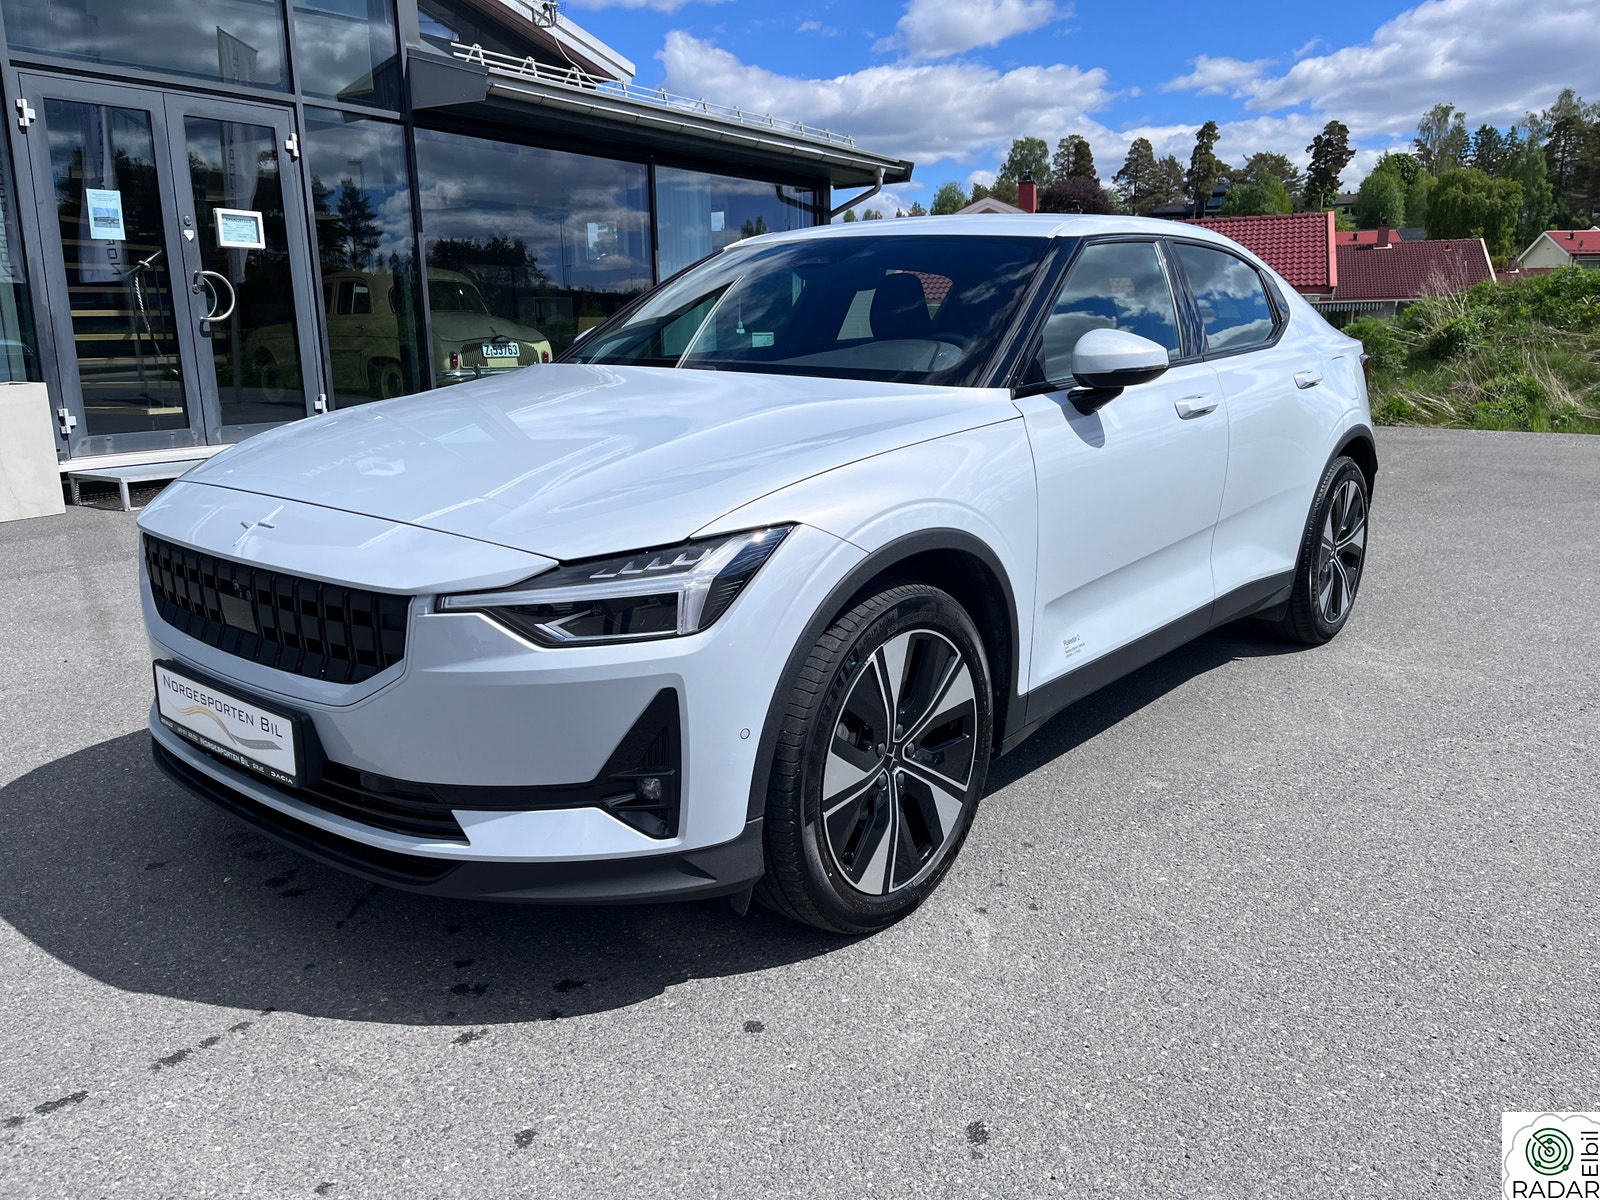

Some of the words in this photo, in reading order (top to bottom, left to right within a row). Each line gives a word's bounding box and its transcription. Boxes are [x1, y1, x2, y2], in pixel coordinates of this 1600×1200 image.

[163, 674, 254, 727] NORGESPORTEN
[260, 717, 283, 738] BIL
[270, 771, 293, 785] DACIA
